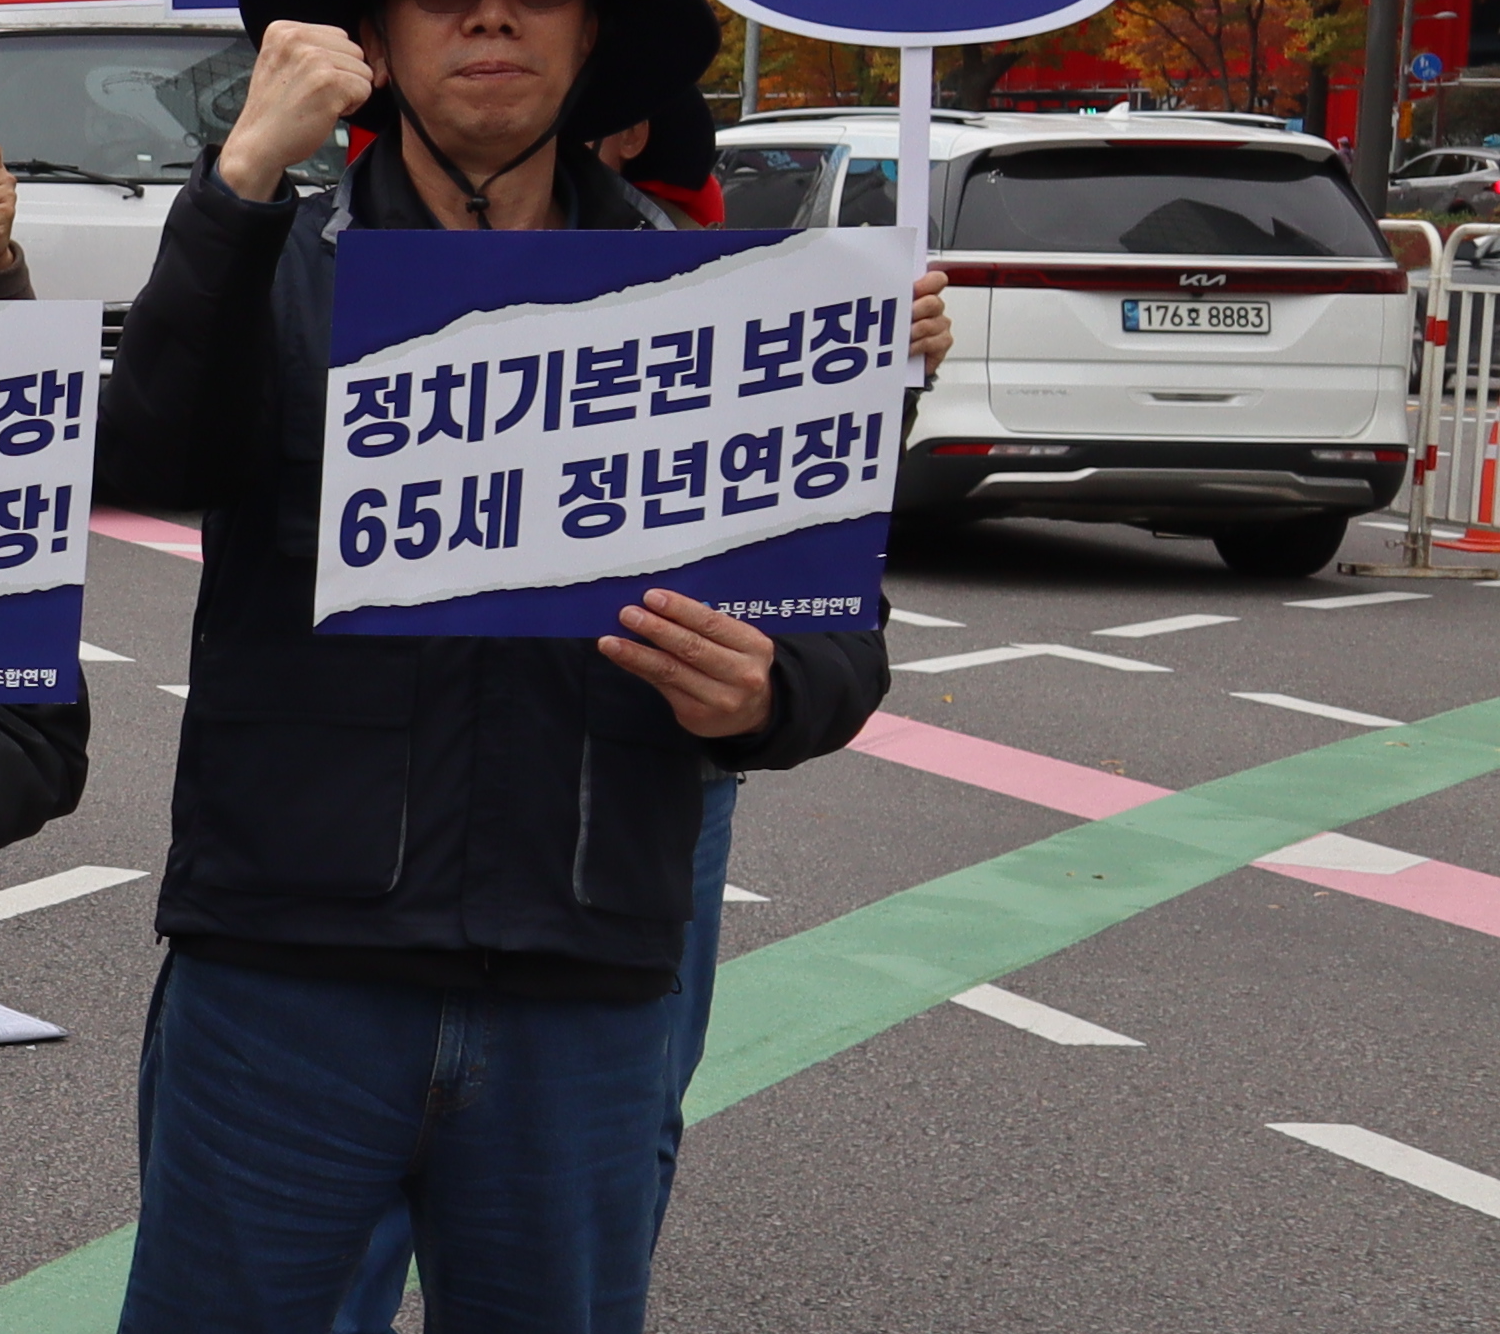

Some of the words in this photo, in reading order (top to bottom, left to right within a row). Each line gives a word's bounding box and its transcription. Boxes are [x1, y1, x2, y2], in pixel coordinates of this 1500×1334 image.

[344, 326, 714, 458] 정치기본권
[738, 297, 897, 398] 보장!
[1142, 304, 1202, 328] 176호
[1208, 306, 1265, 328] 8883
[340, 468, 523, 567] 65세
[559, 412, 883, 539] 정년연장!
